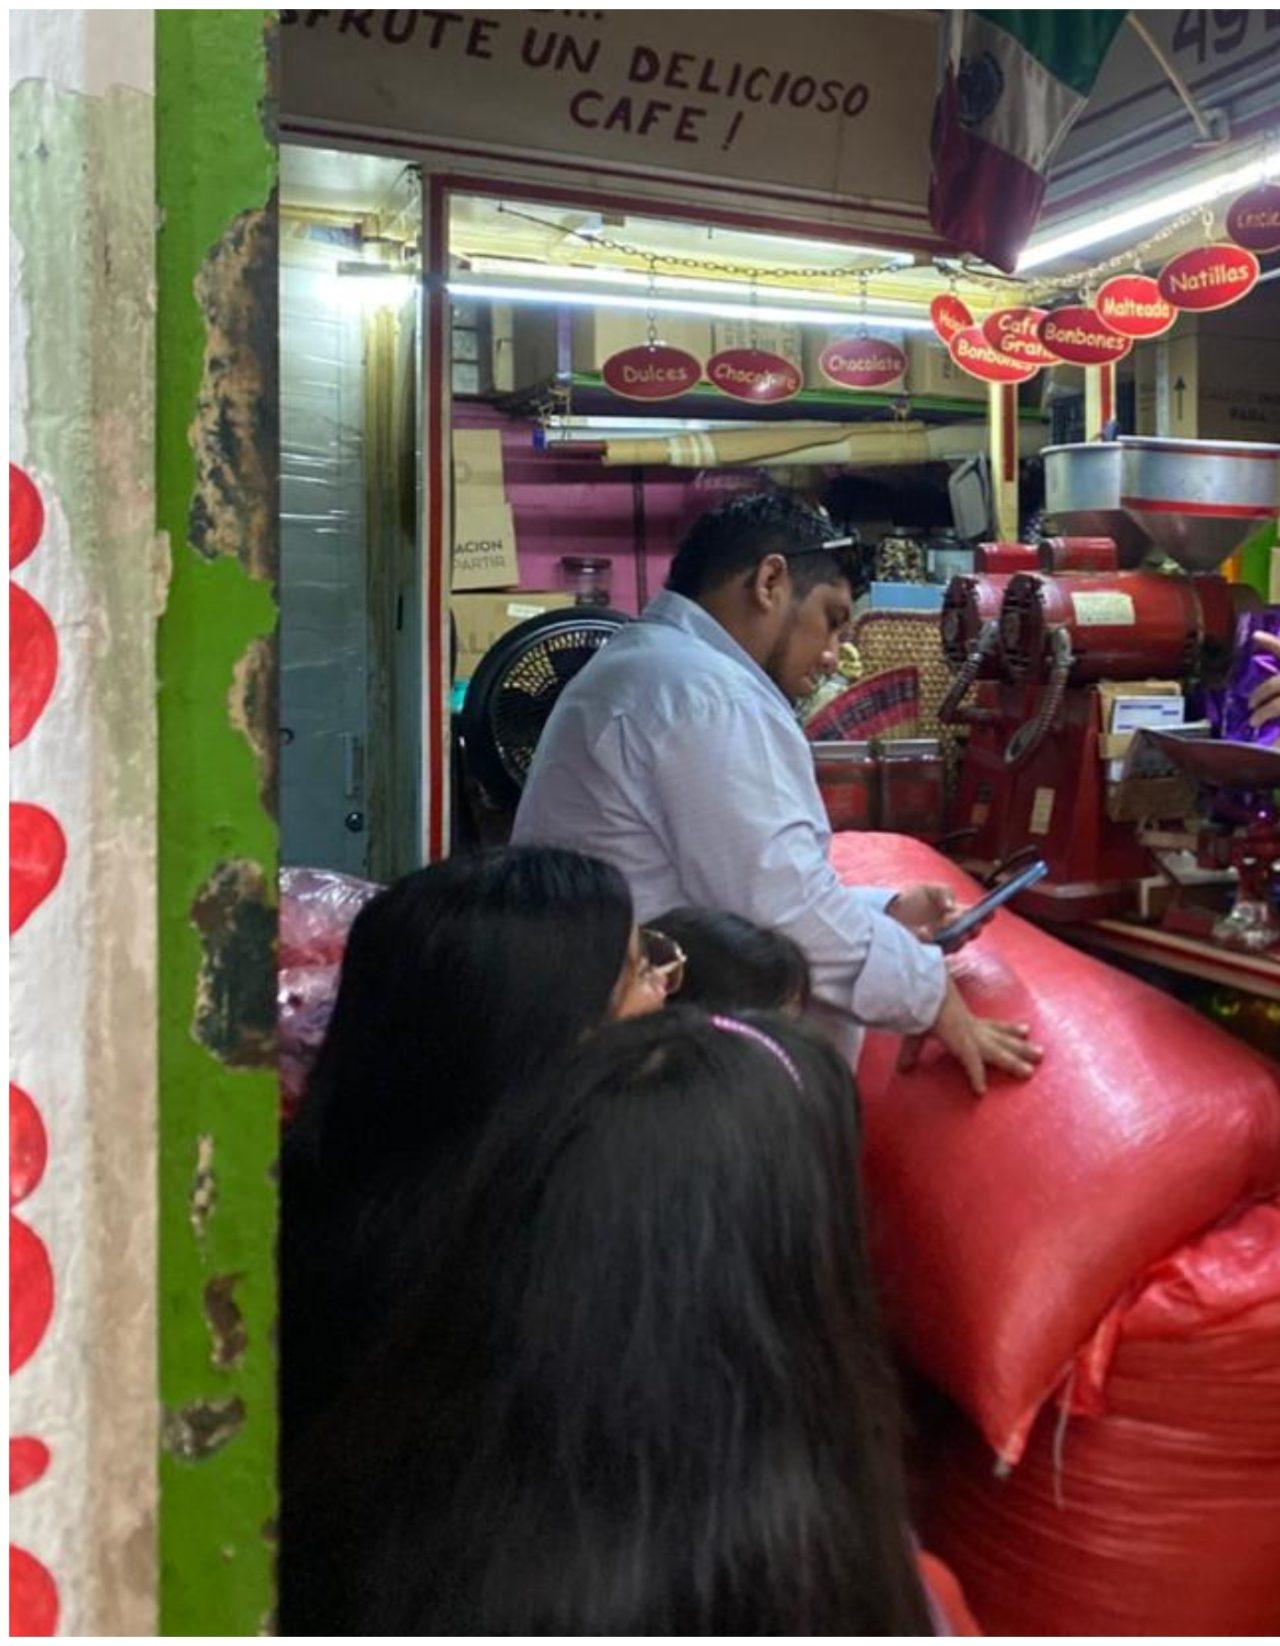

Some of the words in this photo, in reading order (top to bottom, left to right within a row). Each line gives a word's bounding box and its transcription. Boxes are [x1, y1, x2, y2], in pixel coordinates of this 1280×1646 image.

[521, 27, 601, 73] UN
[628, 46, 870, 117] DELICIOSO
[569, 89, 707, 143] CAFE
[1169, 263, 1250, 294] Natillas
[1045, 320, 1125, 351] Bonbones
[621, 364, 688, 383] Dulces
[828, 353, 901, 373] Chocolate
